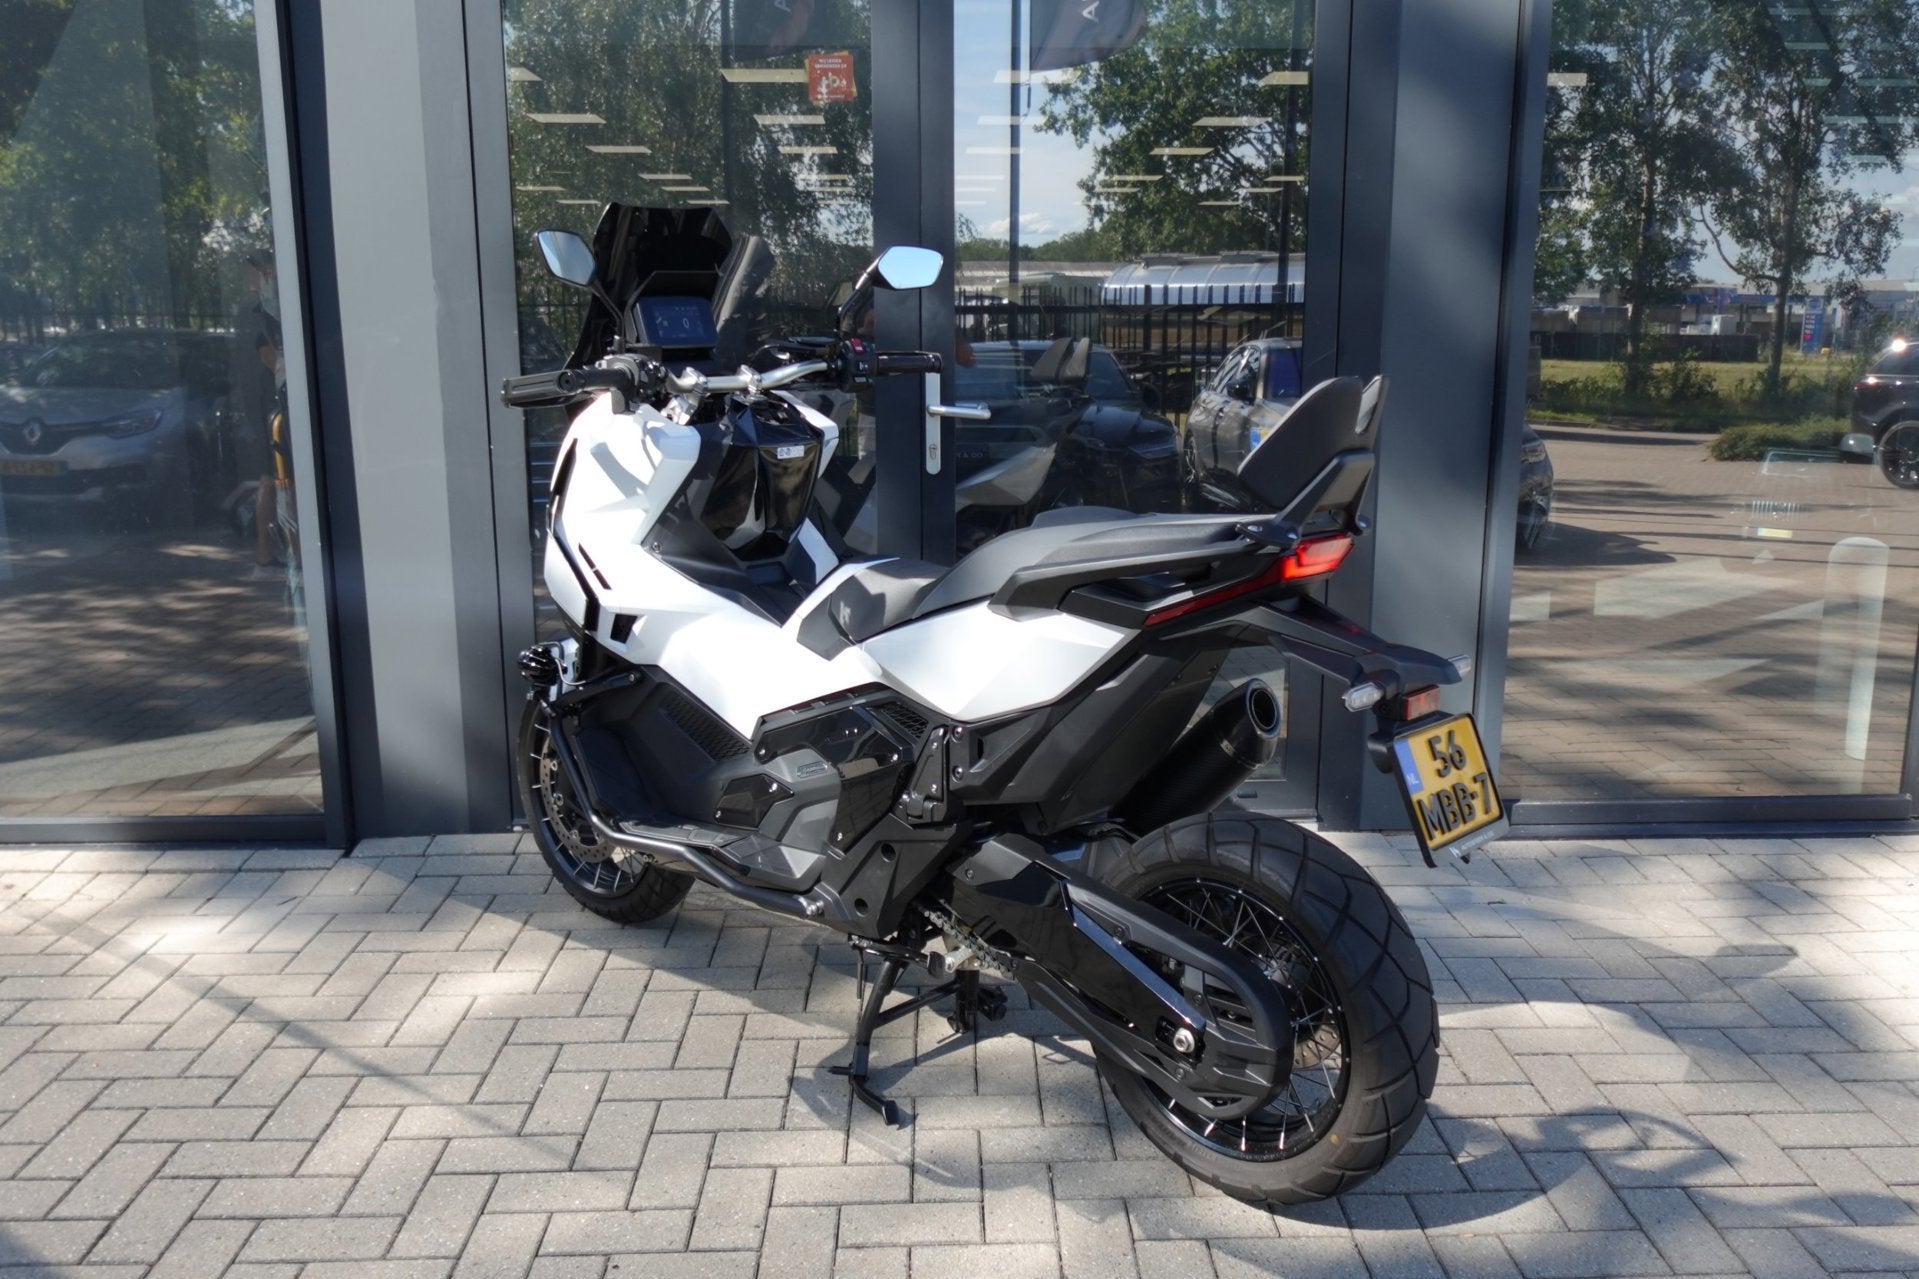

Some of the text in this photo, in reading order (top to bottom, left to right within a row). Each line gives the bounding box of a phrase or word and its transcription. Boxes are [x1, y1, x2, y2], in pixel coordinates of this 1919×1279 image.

[1427, 730, 1467, 778] 56
[1406, 772, 1420, 786] NL
[1417, 772, 1492, 841] MBB-7
